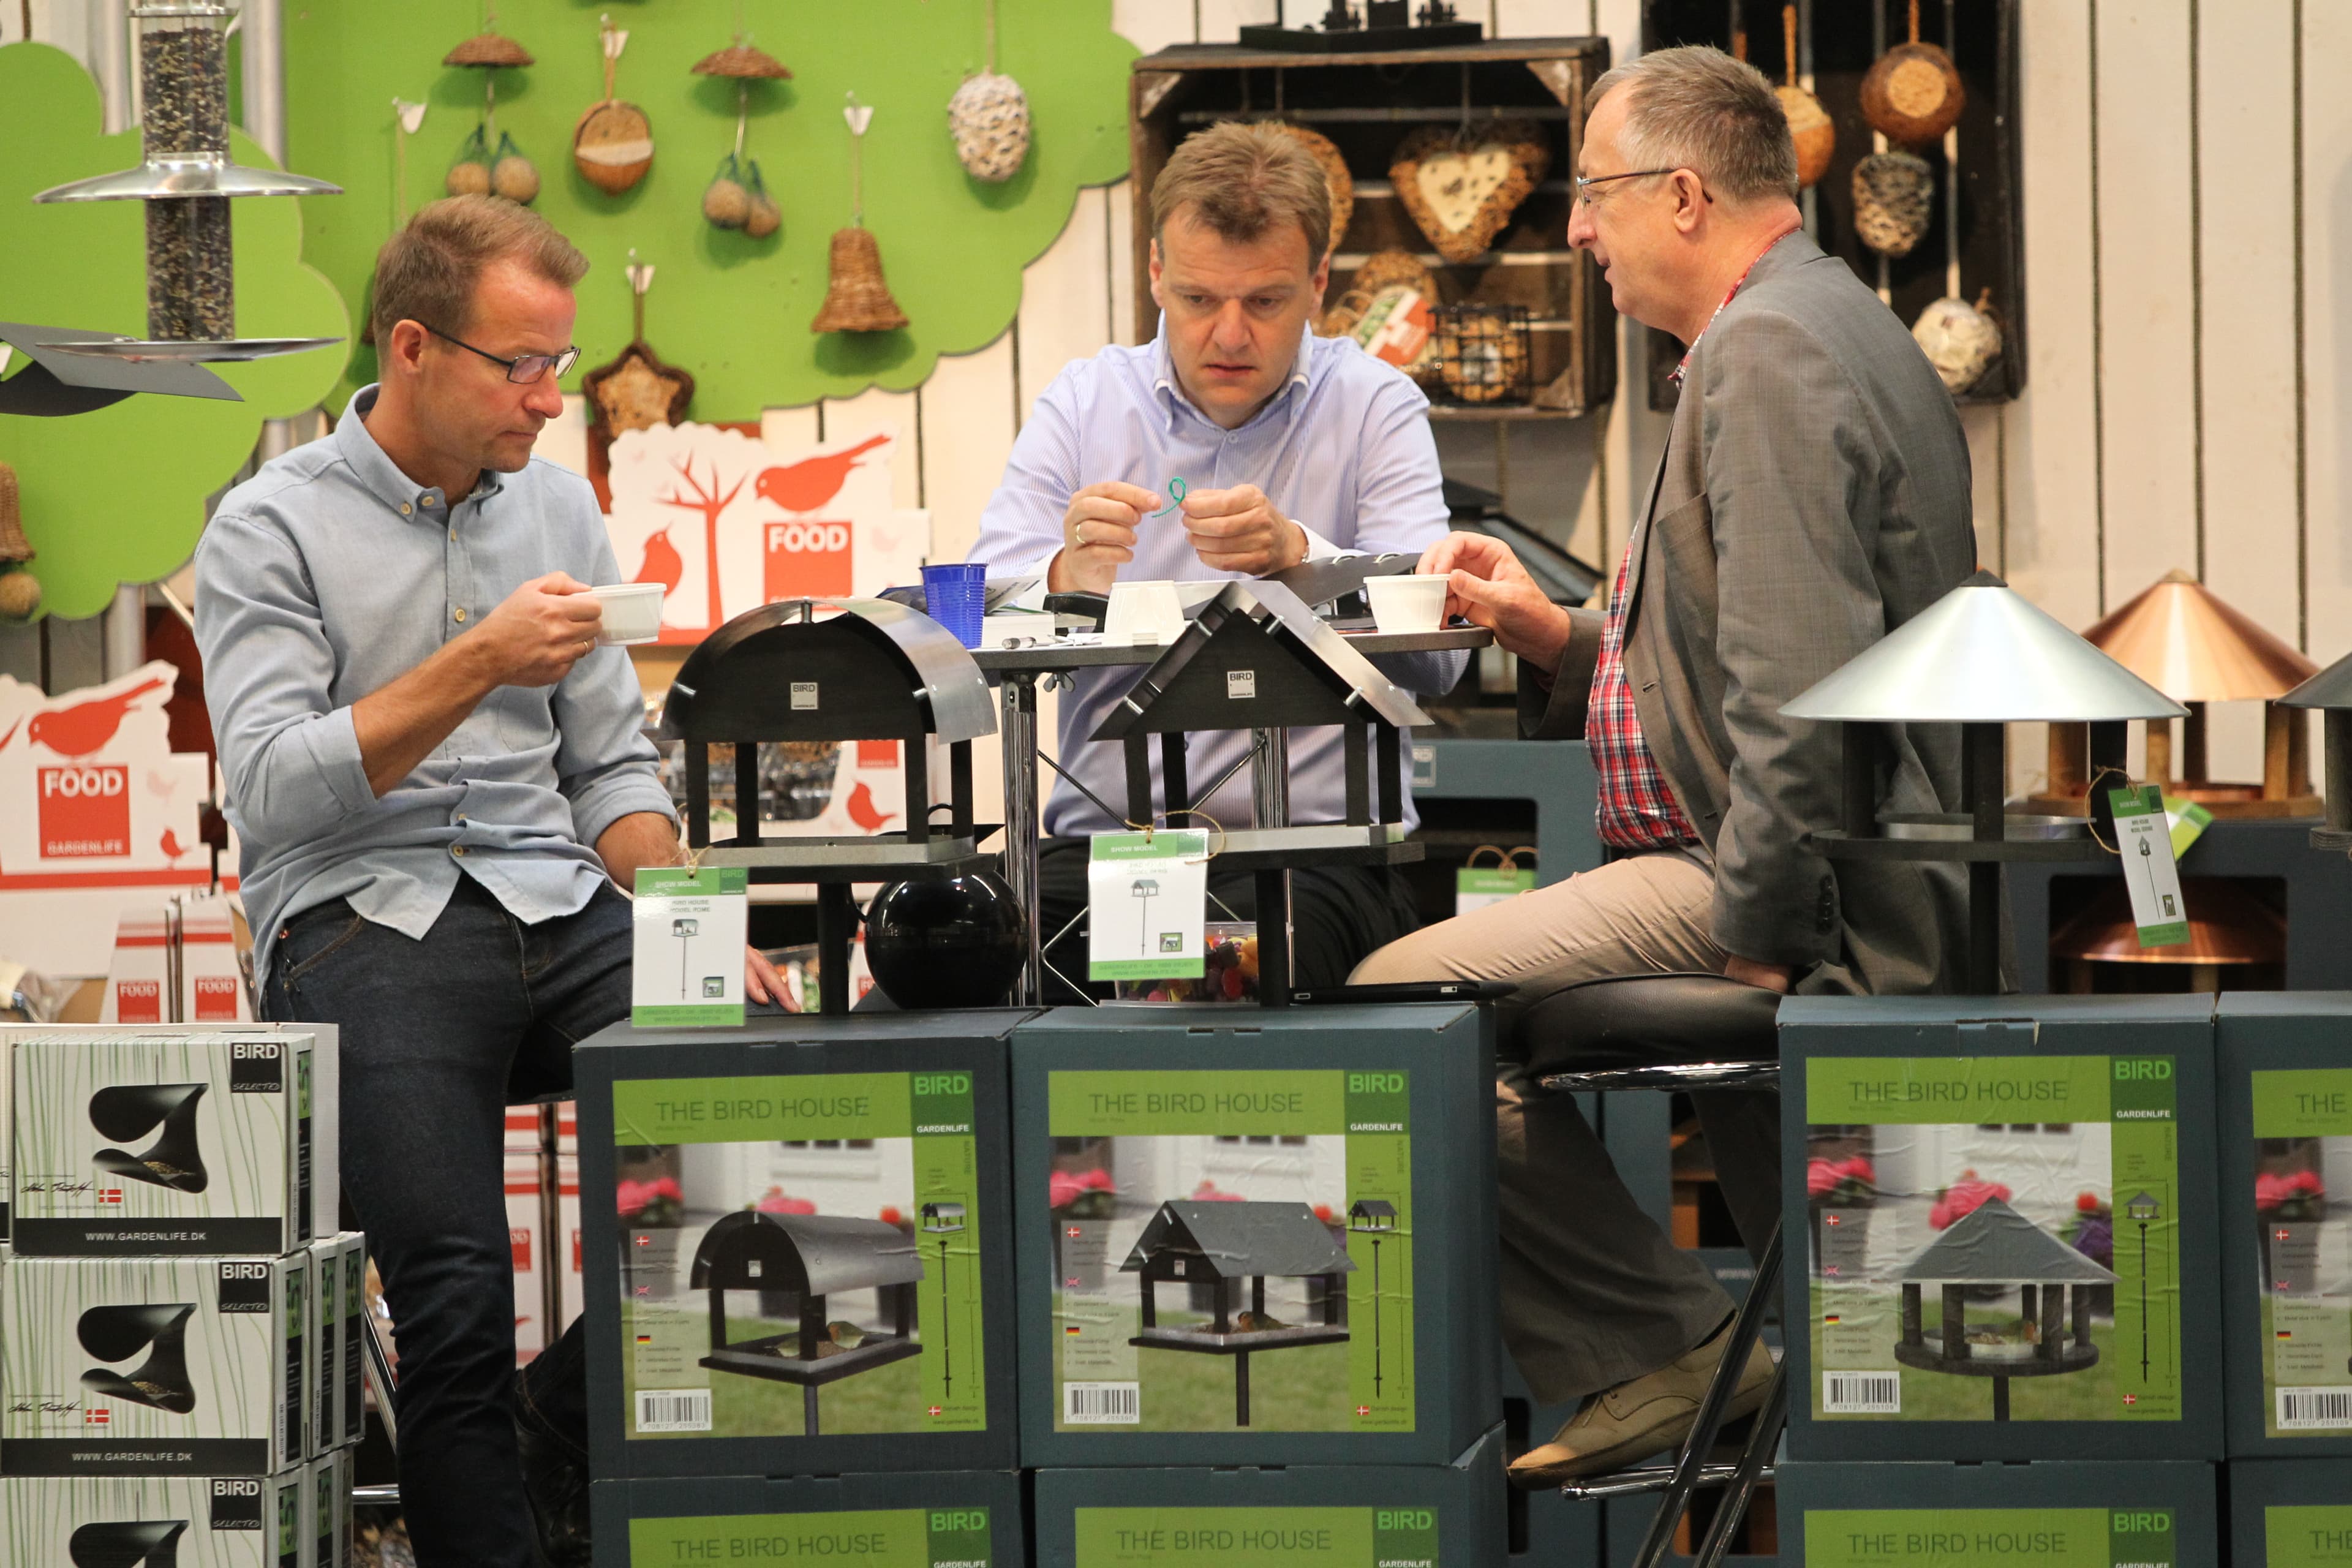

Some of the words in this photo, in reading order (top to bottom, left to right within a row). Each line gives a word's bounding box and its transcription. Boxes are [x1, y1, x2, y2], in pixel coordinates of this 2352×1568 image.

[769, 525, 848, 552] FOOD
[45, 769, 123, 797] FOOD
[47, 839, 123, 855] GARDENLIFE
[119, 984, 157, 997] FOOD
[198, 980, 234, 993] FOOD
[233, 1044, 278, 1058] BIRD
[2115, 1061, 2170, 1080] BIRD
[914, 1076, 969, 1095] BIRD
[1349, 1074, 1403, 1093] BIRD
[1848, 1082, 1899, 1101] THE
[1909, 1082, 1967, 1101] BIRD
[1977, 1080, 2068, 1101] HOUSE
[655, 1101, 705, 1121] THE
[714, 1100, 772, 1120] BIRD
[782, 1097, 869, 1118] HOUSE
[1088, 1093, 1138, 1113] THE
[1147, 1093, 1205, 1113] BIRD
[1215, 1093, 1303, 1113] HOUSE
[2294, 1093, 2347, 1113] THE
[2117, 1110, 2170, 1118] GARDENLIFE
[917, 1125, 970, 1134] GARDENLIFE
[1351, 1123, 1403, 1131] GARDENLIFE
[86, 1232, 206, 1241] WWW.GARDENLIFE.DK
[222, 1264, 268, 1279] BIRD
[222, 1303, 268, 1311] SELECTED
[72, 1453, 192, 1461] WWW.GARDENLIFE.DK
[214, 1480, 260, 1496] BIRD
[214, 1520, 261, 1528] SELECTED
[931, 1512, 986, 1531] BIRD
[1378, 1512, 1432, 1530] BIRD
[2114, 1513, 2169, 1532] BIRD
[673, 1539, 720, 1559] THE
[730, 1537, 789, 1558] BIRD
[798, 1534, 886, 1555] HOUSE
[1115, 1531, 1165, 1550] THE
[1175, 1531, 1232, 1550] BIRD
[1243, 1531, 1331, 1550] HOUSE
[1847, 1534, 1898, 1554] THE
[1907, 1534, 1966, 1554] BIRD
[1977, 1532, 2067, 1553] HOUSE
